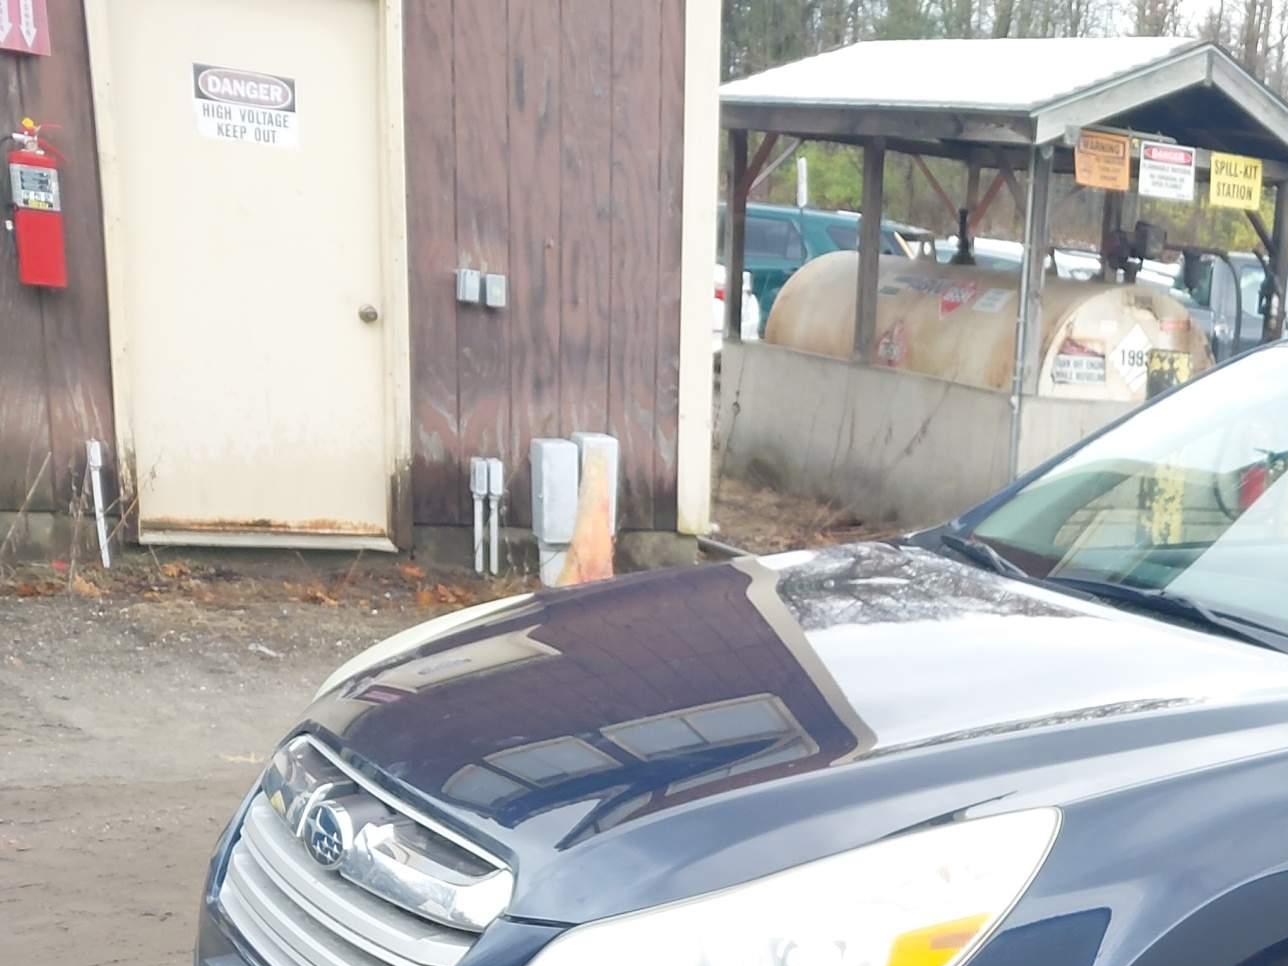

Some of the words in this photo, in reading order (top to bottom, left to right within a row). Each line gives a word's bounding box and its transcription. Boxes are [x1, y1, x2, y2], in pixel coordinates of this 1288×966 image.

[207, 75, 283, 103] DANGER
[202, 103, 232, 121] HIGH
[240, 108, 290, 128] VOLTAGE
[216, 122, 247, 139] KEEP
[254, 127, 277, 144] OUT
[1214, 160, 1258, 180] SPILL-KIT
[1216, 182, 1253, 201] STATION
